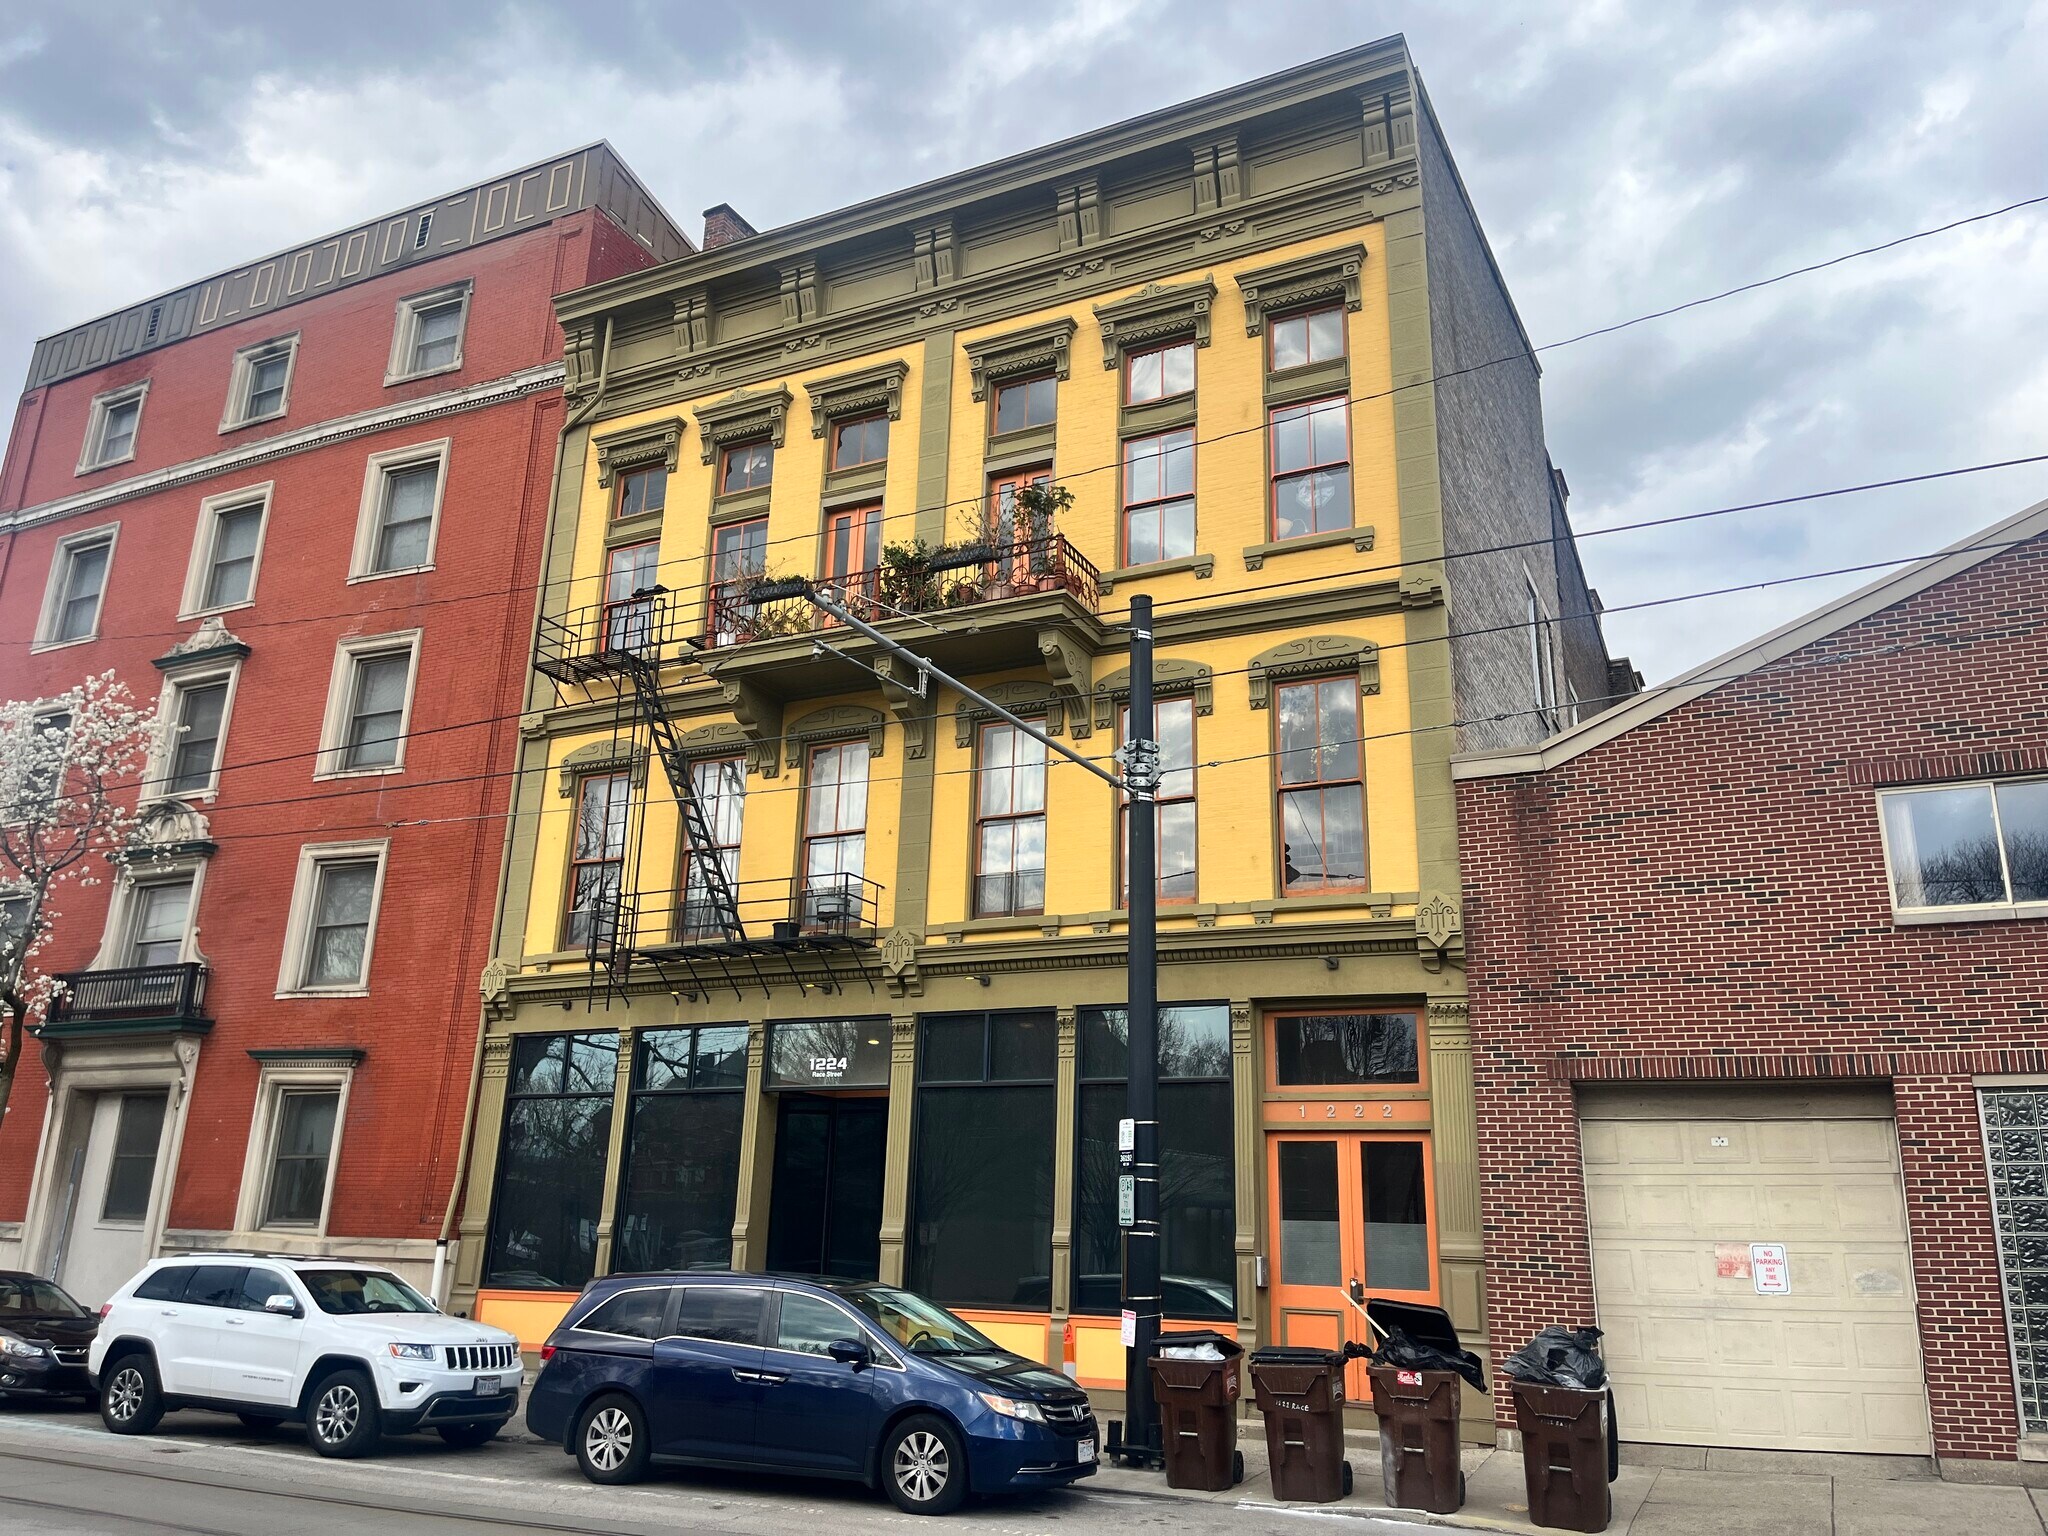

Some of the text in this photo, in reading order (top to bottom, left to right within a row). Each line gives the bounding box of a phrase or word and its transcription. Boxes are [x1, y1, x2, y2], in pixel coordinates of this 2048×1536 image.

[810, 1057, 848, 1071] 1224
[1299, 1104, 1393, 1119] 1222
[1756, 1258, 1783, 1266] PARKING
[1291, 1403, 1310, 1412] RACE
